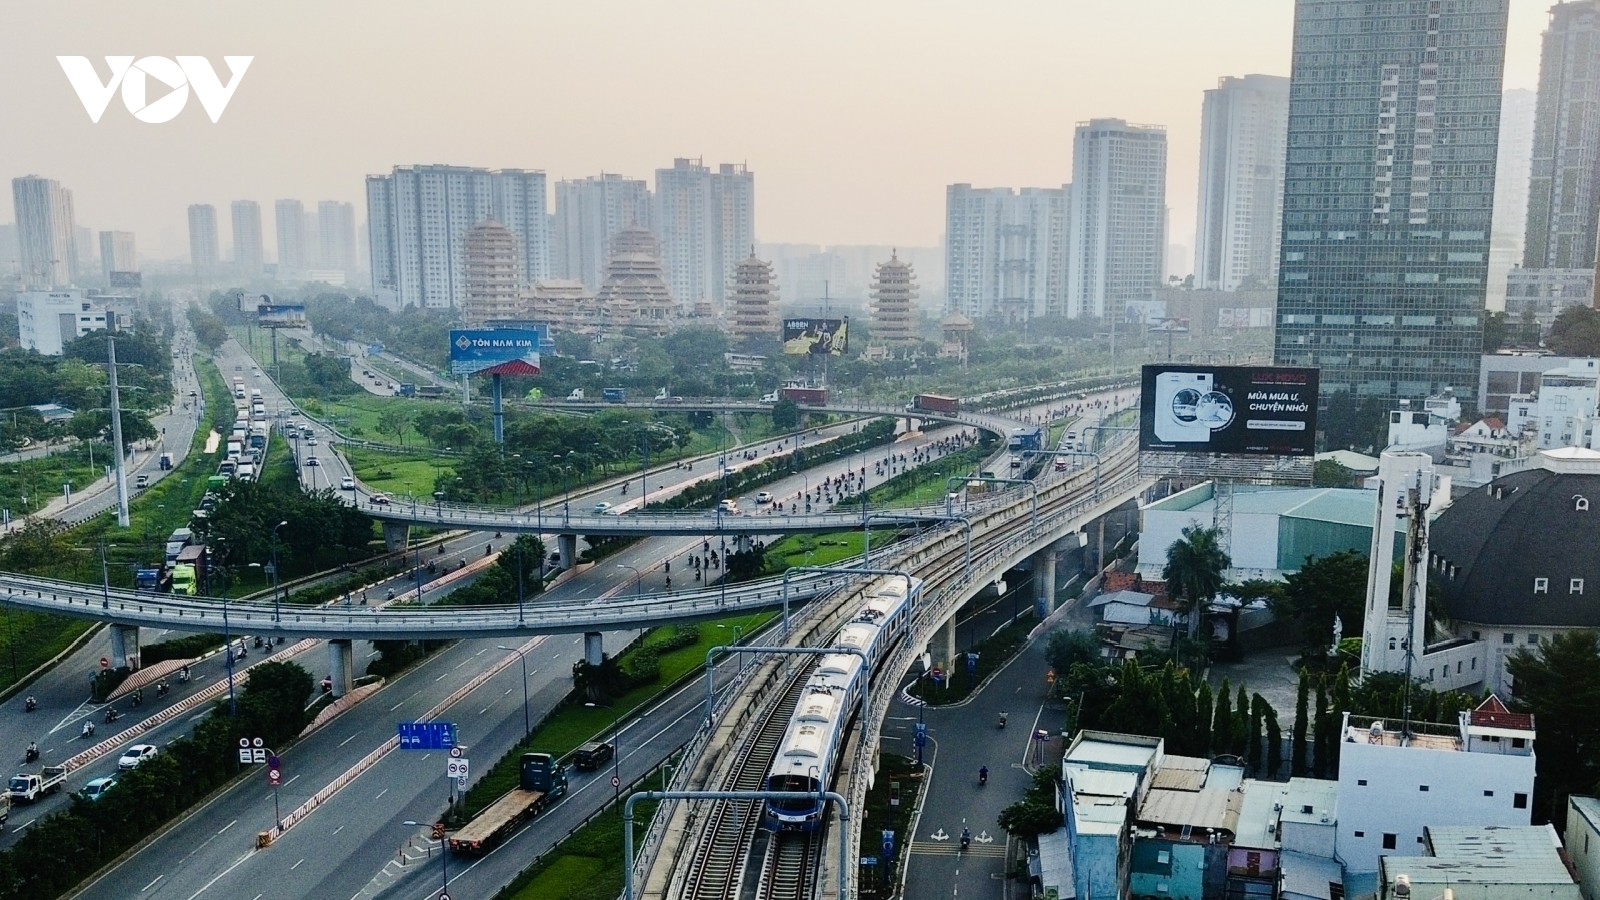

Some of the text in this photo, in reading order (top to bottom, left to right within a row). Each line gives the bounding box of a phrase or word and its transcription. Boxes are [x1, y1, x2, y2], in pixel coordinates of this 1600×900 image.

[472, 338, 532, 347] TÔN NAM KIM
[1269, 392, 1289, 401] MƯA
[1249, 401, 1285, 413] CHUYỆN
